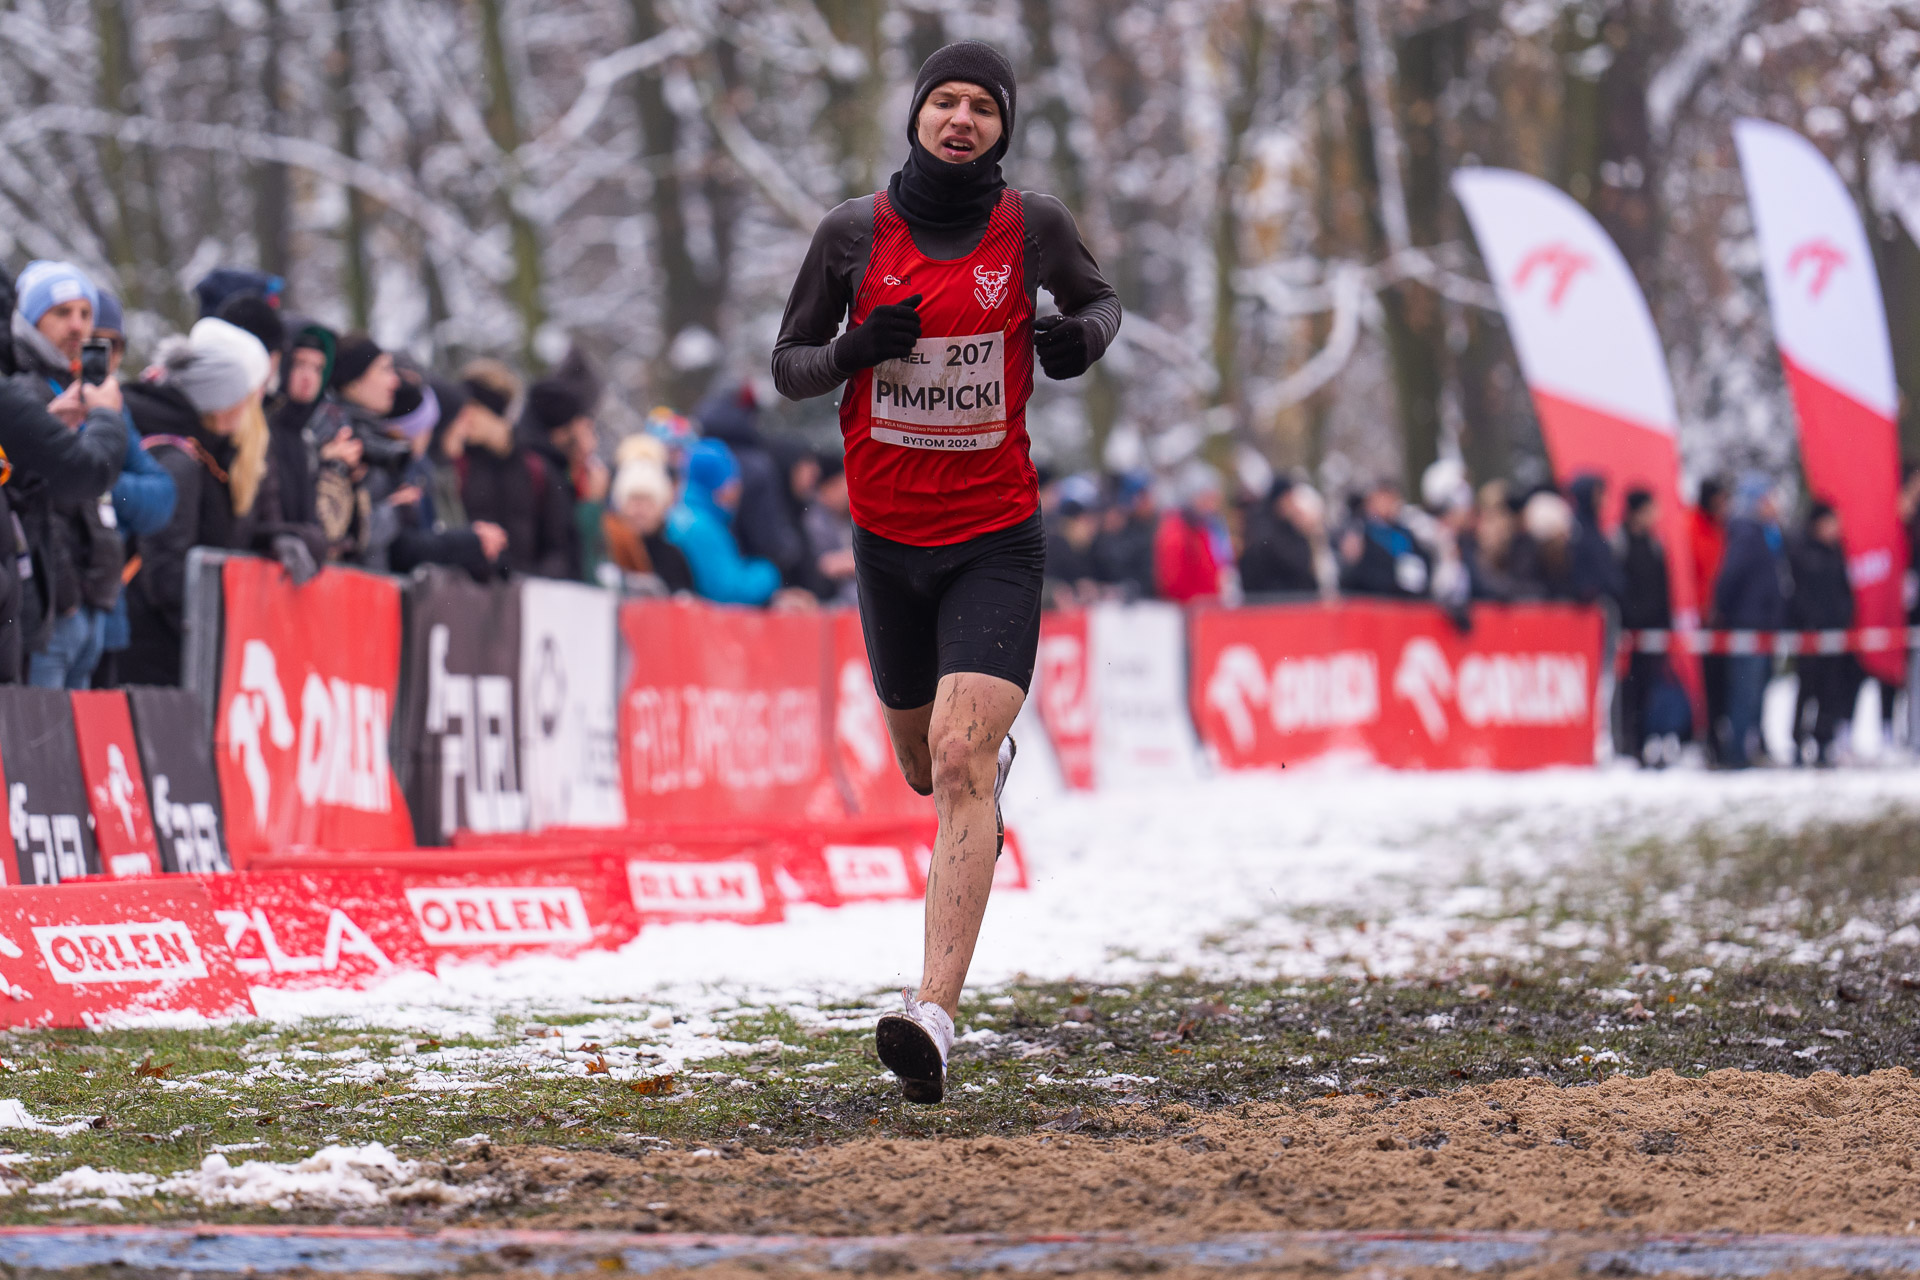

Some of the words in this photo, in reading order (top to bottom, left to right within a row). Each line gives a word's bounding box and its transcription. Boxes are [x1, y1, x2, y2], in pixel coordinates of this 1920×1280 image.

[946, 341, 994, 367] 207
[876, 379, 1001, 411] PIMPICKI
[902, 436, 945, 448] BYTOM
[947, 439, 978, 448] 2024
[949, 426, 971, 435] Biegach
[420, 897, 573, 933] ORLEN
[51, 931, 191, 974] ORLEN
[216, 907, 395, 974] ZLA
